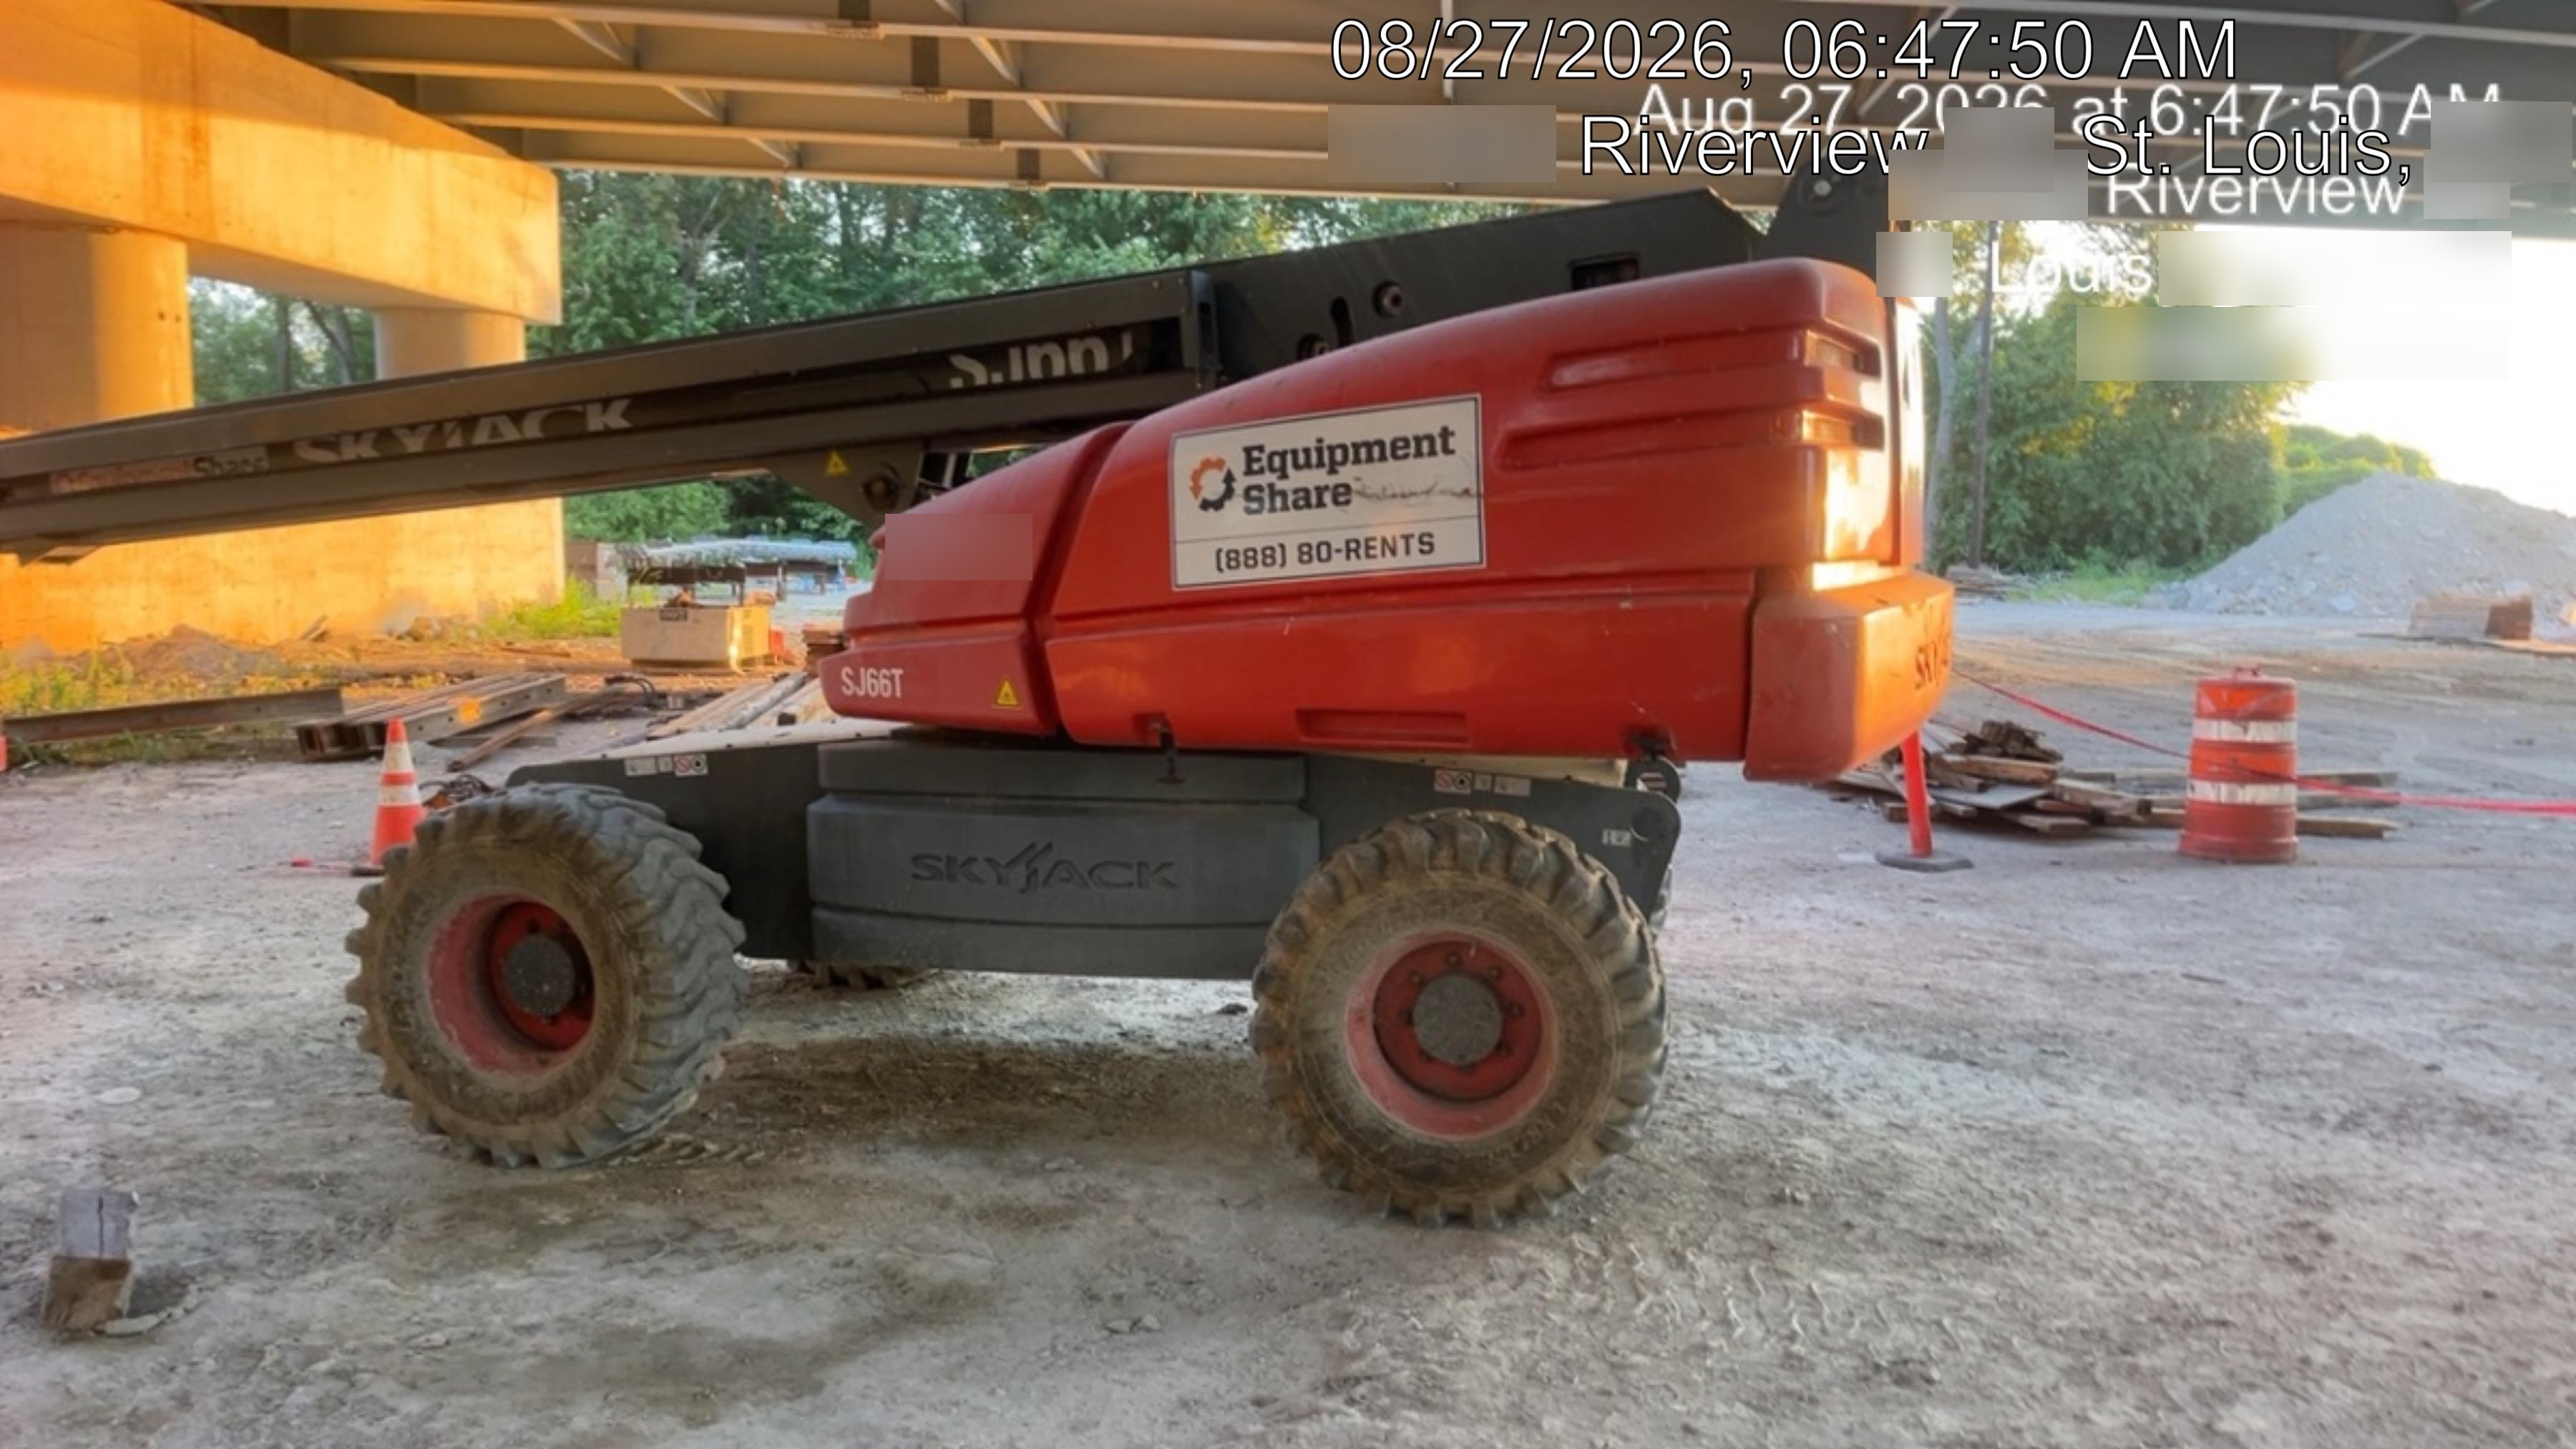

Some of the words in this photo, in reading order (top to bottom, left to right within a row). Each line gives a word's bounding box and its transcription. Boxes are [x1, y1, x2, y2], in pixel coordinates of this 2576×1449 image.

[1242, 426, 1455, 480] Equipment
[1242, 482, 1352, 515] Share
[1215, 543, 1287, 573] (888)
[1297, 532, 1435, 565] 80-RENTS
[840, 668, 904, 698] SJ66T
[910, 841, 1179, 894] SKYJACK
